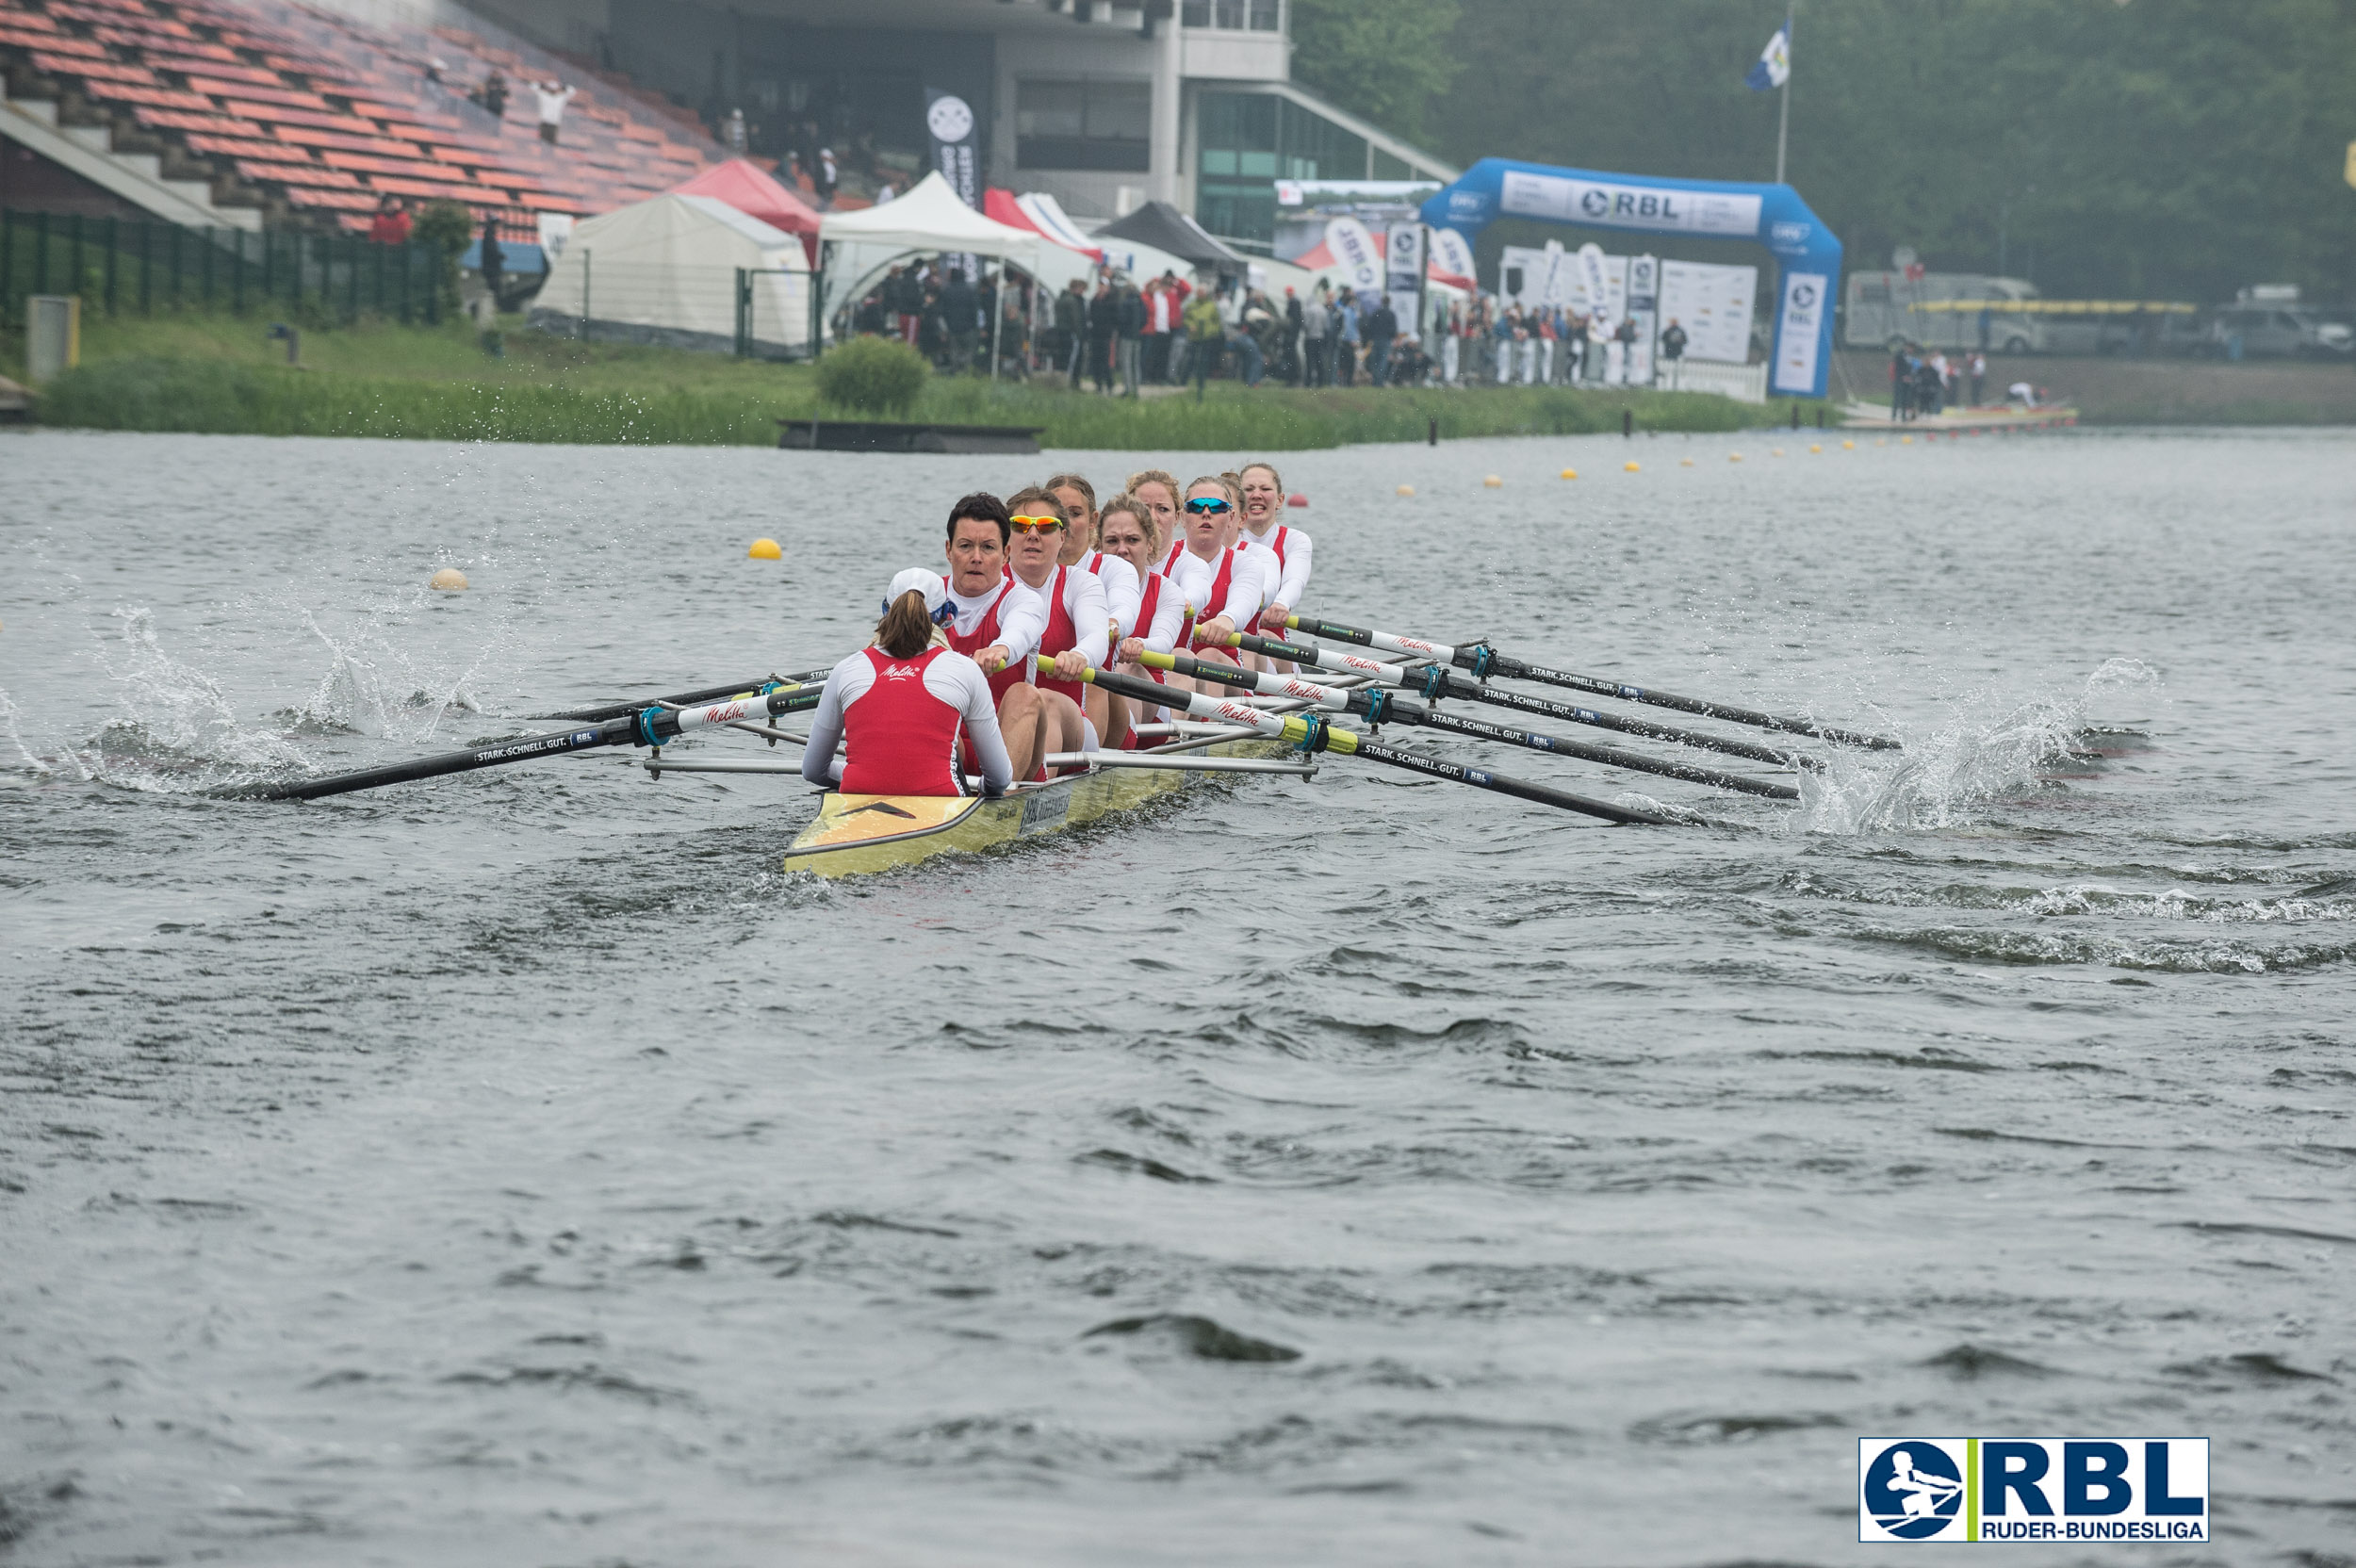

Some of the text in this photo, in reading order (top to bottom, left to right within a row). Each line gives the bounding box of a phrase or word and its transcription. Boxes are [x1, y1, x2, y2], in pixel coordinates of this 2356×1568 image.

[1616, 193, 1678, 219] RBL
[1391, 636, 1433, 654] Melitta
[878, 663, 917, 678] Melitta
[1338, 655, 1383, 674] Melitta
[1277, 679, 1325, 702] Melitta
[1531, 667, 1558, 679] STARK.
[1559, 673, 1595, 688] SCHNELL.
[1625, 687, 1638, 695] RBL
[702, 702, 747, 726] Melitta
[1210, 701, 1259, 727] Melitta
[1484, 689, 1595, 719] STARK. SCHNELL. GUT. RBL
[1432, 713, 1548, 745] STARK. SCHNELL. GUT. RBL
[478, 732, 593, 761] STARK. SCHNELL. GUT. RBL
[1366, 744, 1487, 782] STARK. SCHNELL. GUT. RBL
